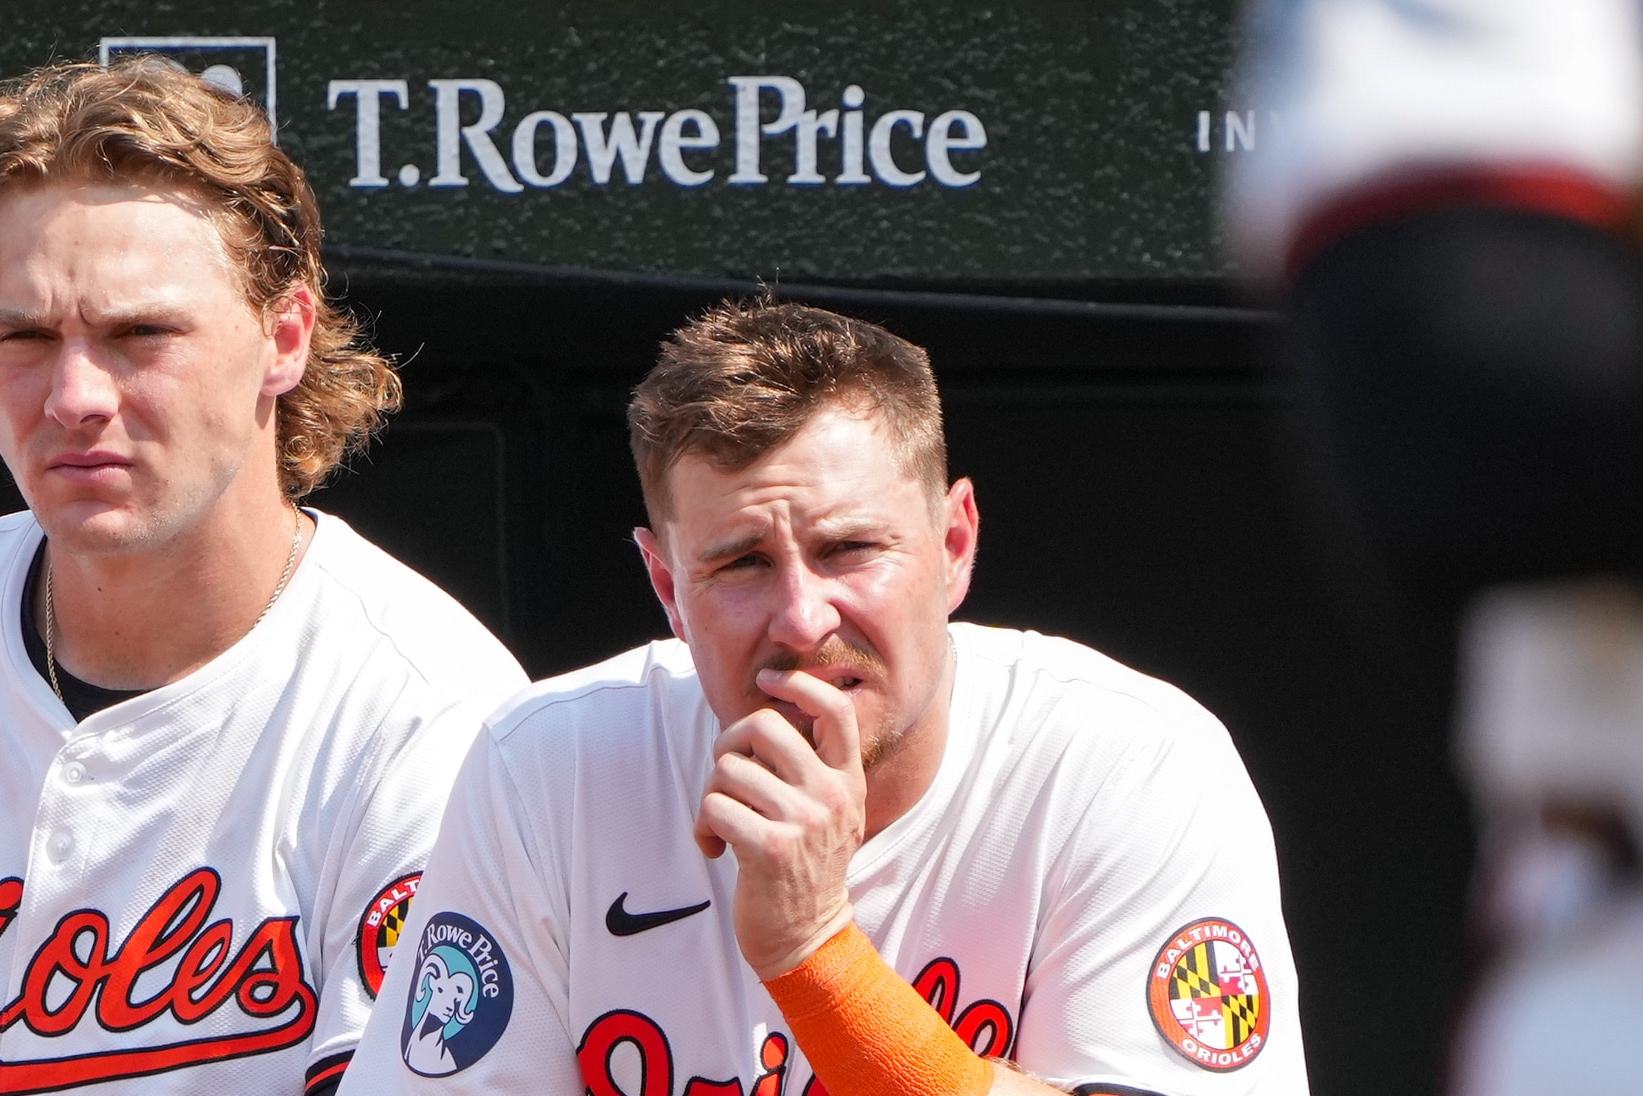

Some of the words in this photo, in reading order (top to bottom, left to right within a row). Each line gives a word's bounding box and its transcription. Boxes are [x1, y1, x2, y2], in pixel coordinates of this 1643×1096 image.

[1198, 110, 1259, 152] IN
[467, 934, 500, 998] Price
[1156, 924, 1260, 980] BALTIMORE
[1181, 1033, 1262, 1066] ORIOLES
